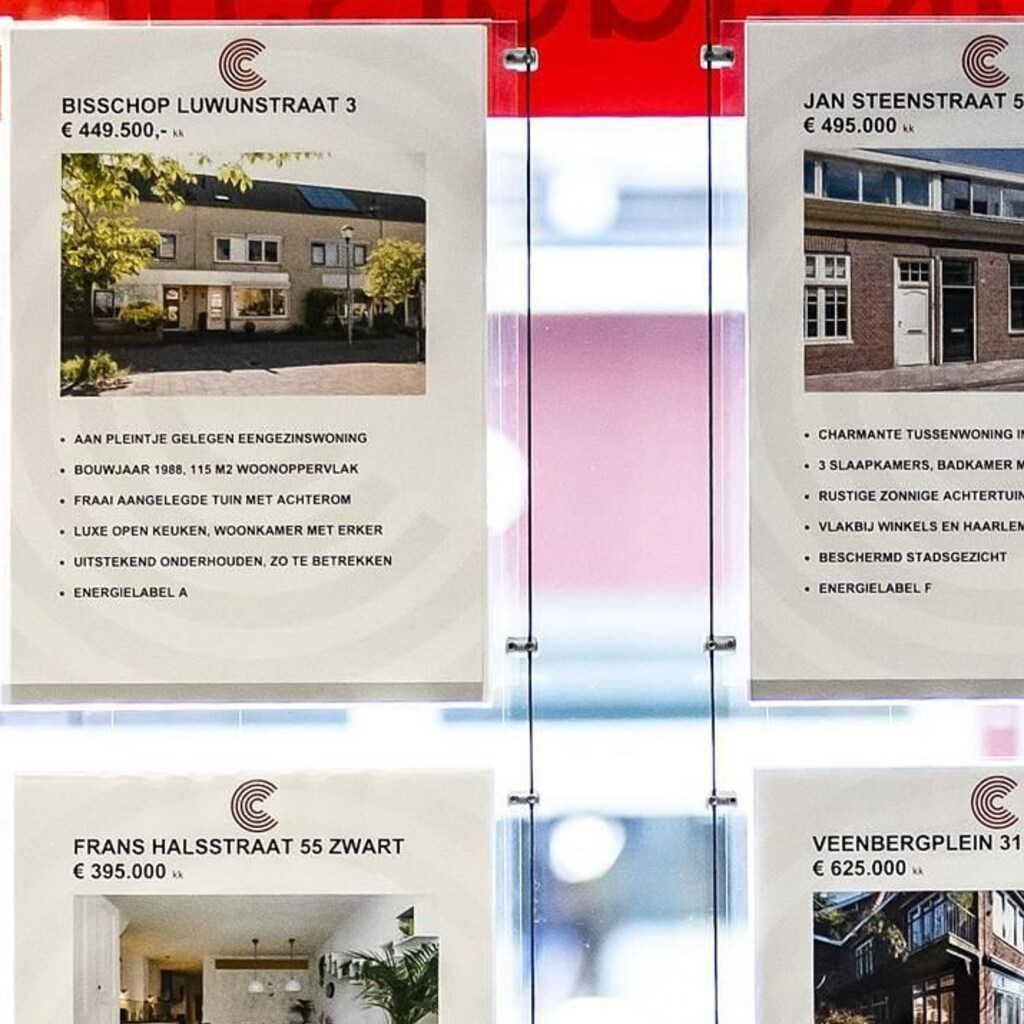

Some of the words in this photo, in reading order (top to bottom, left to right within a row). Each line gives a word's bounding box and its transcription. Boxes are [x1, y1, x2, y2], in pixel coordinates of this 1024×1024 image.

[62, 96, 171, 115] BISSCHOP
[177, 95, 340, 114] LUWUNSTRAAT
[345, 96, 357, 114] 3
[803, 92, 845, 110] JAN
[851, 92, 1008, 110] STEENSTRAAT
[1012, 92, 1024, 110] 5
[60, 121, 73, 139] €
[78, 121, 168, 141] 449.500,-
[172, 128, 185, 138] kk
[802, 116, 816, 134] €
[820, 116, 898, 134] 495.000
[902, 123, 915, 134] kk
[73, 433, 103, 445] AAN
[105, 433, 168, 445] PLEINTJE
[170, 432, 235, 445] GELEGEN
[237, 432, 368, 445] EENGEZINSWONING
[818, 428, 903, 441] CHARMANTE
[905, 428, 1014, 441] TUSSENWONING
[73, 463, 151, 476] BOUWJAAR
[154, 463, 187, 476] 1988,
[190, 463, 212, 475] 115
[214, 463, 233, 475] M2
[235, 462, 359, 476] WOONOPPERVLAK
[818, 459, 826, 471] 3
[829, 459, 934, 473] SLAAPKAMERS,
[936, 459, 1013, 471] BADKAMER
[73, 494, 114, 507] FRAAI
[116, 494, 209, 507] AANGELEGDE
[211, 494, 243, 506] TUIN
[245, 493, 274, 506] MET
[276, 493, 352, 506] ACHTEROM
[818, 489, 877, 502] RUSTIGE
[879, 489, 940, 502] ZONNIGE
[73, 525, 109, 538] LUXE
[111, 525, 149, 537] OPEN
[152, 524, 211, 538] KEUKEN,
[213, 524, 304, 537] WOONKAMER
[306, 524, 335, 537] MET
[337, 524, 384, 537] ERKER
[818, 520, 875, 533] VLAKBIJ
[877, 520, 938, 533] WINKELS
[941, 520, 960, 533] EN
[818, 551, 903, 564] BESCHERMD
[906, 550, 1008, 563] STADSGEZICHT
[73, 586, 176, 599] ENERGIELABEL
[178, 586, 189, 598] A
[818, 582, 922, 594] ENERGIELABEL
[924, 582, 933, 594] F
[73, 838, 146, 856] FRANS
[152, 838, 295, 856] HALSSTRAAT
[299, 838, 323, 855] 55
[328, 837, 406, 855] ZWART
[811, 833, 993, 853] VEENBERGPLEIN
[999, 833, 1021, 851] 31
[72, 862, 85, 880] €
[90, 862, 167, 880] 395.000
[172, 870, 184, 880] kk
[811, 859, 825, 877] €
[830, 858, 907, 877] 625.000
[912, 866, 924, 875] kk
